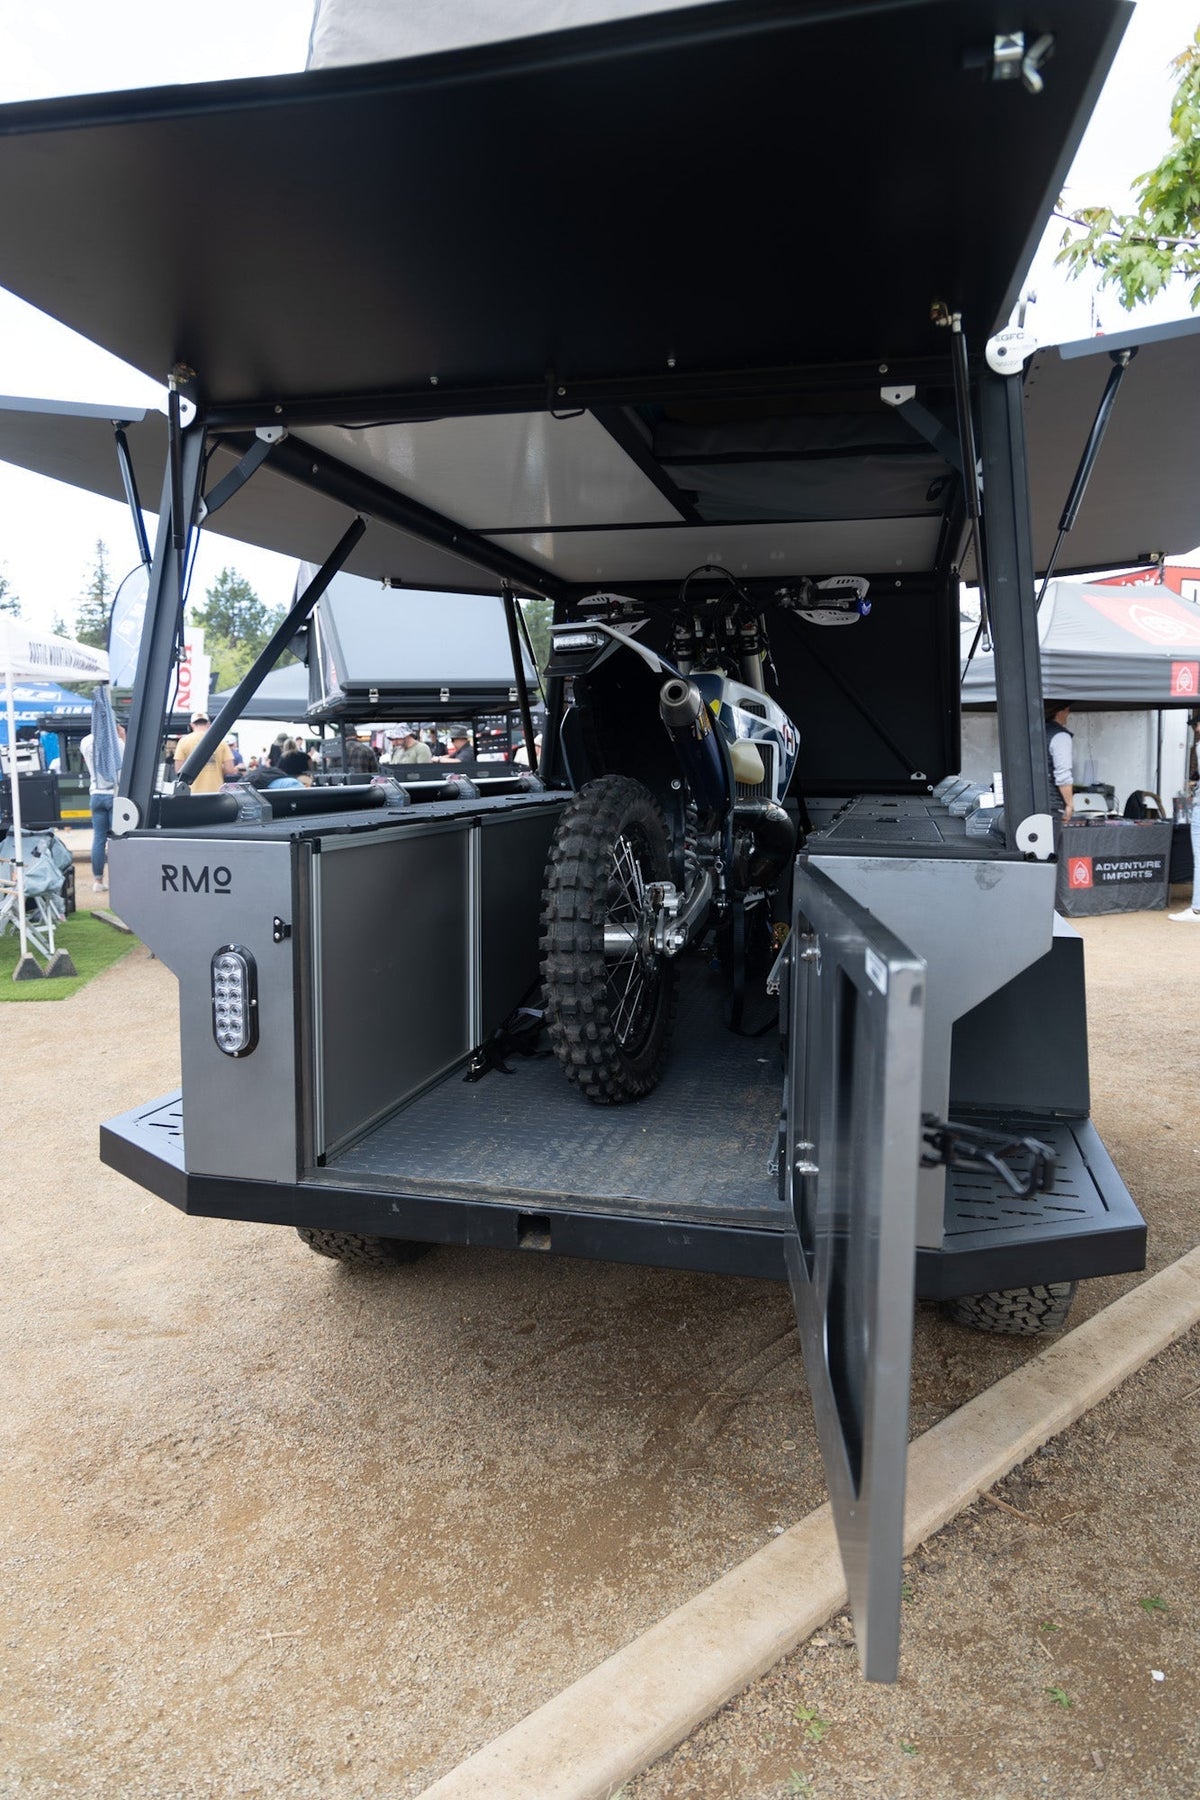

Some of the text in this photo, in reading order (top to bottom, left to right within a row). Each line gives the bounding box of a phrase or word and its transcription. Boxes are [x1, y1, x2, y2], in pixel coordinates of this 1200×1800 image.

[1095, 860, 1162, 871] ADVENTURE
[161, 864, 232, 894] RMO
[1102, 870, 1153, 880] IMPORTS
